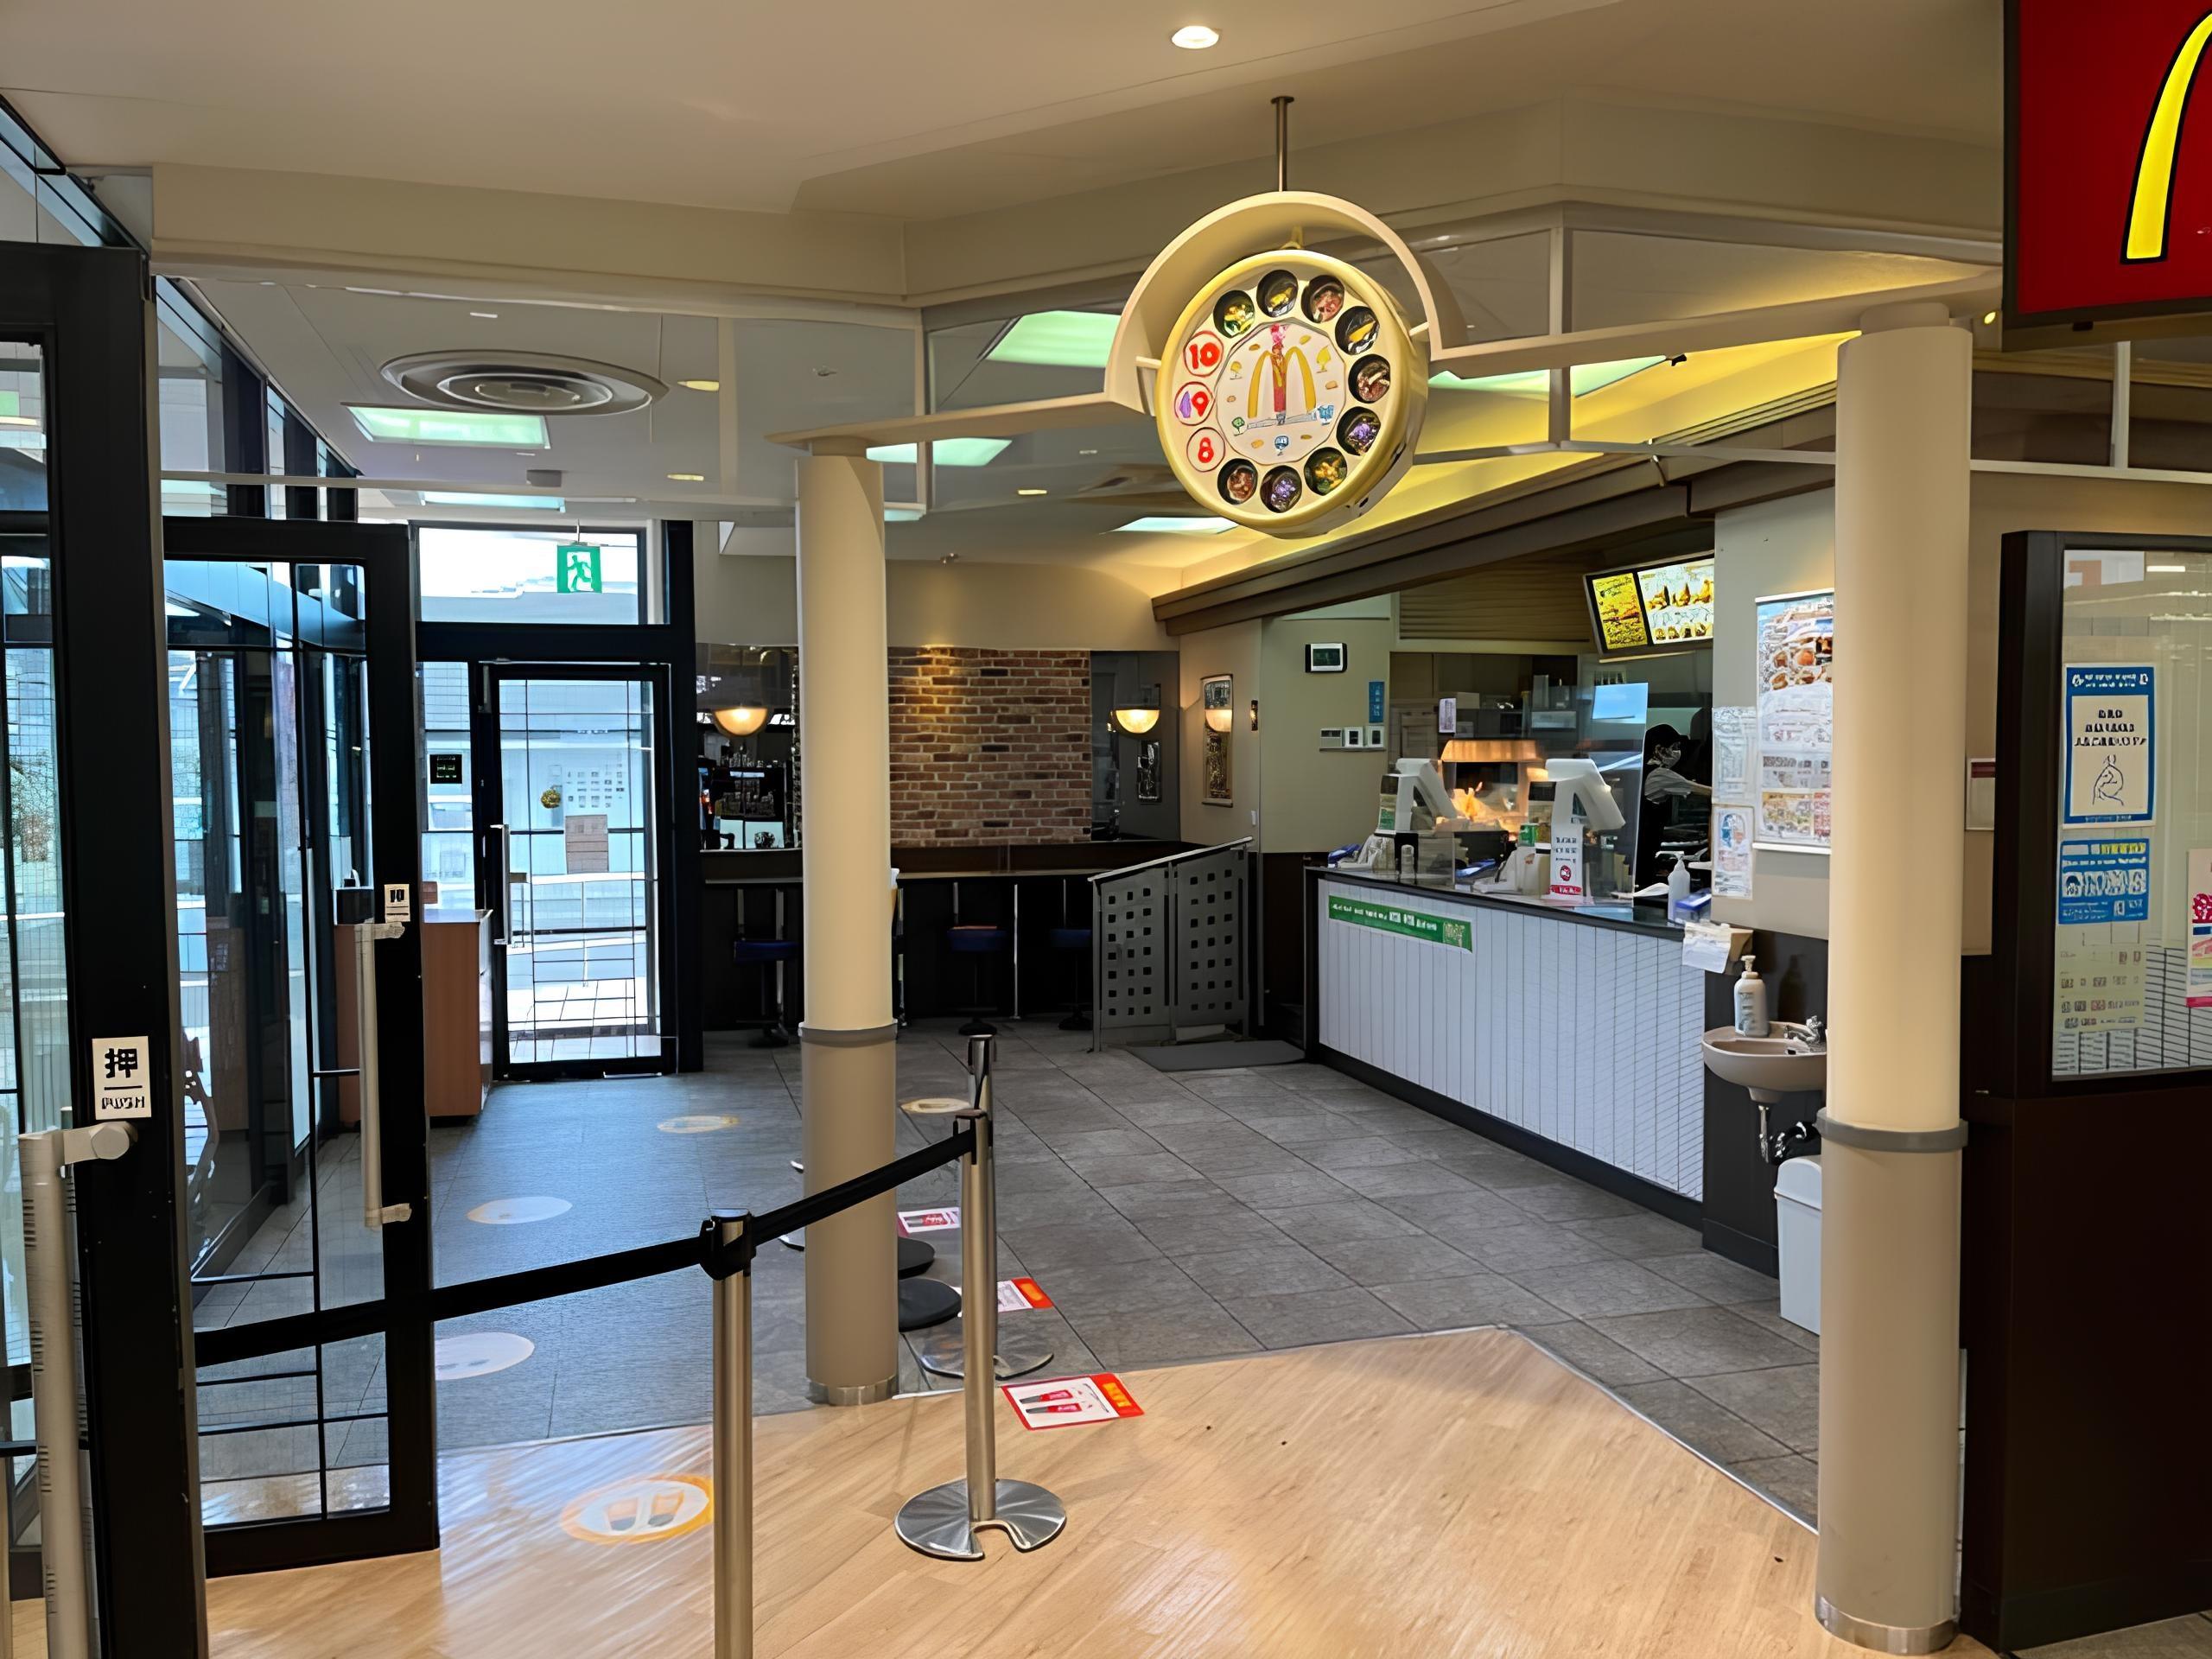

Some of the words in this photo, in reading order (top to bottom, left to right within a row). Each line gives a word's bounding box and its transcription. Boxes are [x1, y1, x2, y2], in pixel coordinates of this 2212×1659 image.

[1190, 342, 1220, 370] 10
[1198, 437, 1215, 463] 8
[105, 1047, 138, 1078] 押
